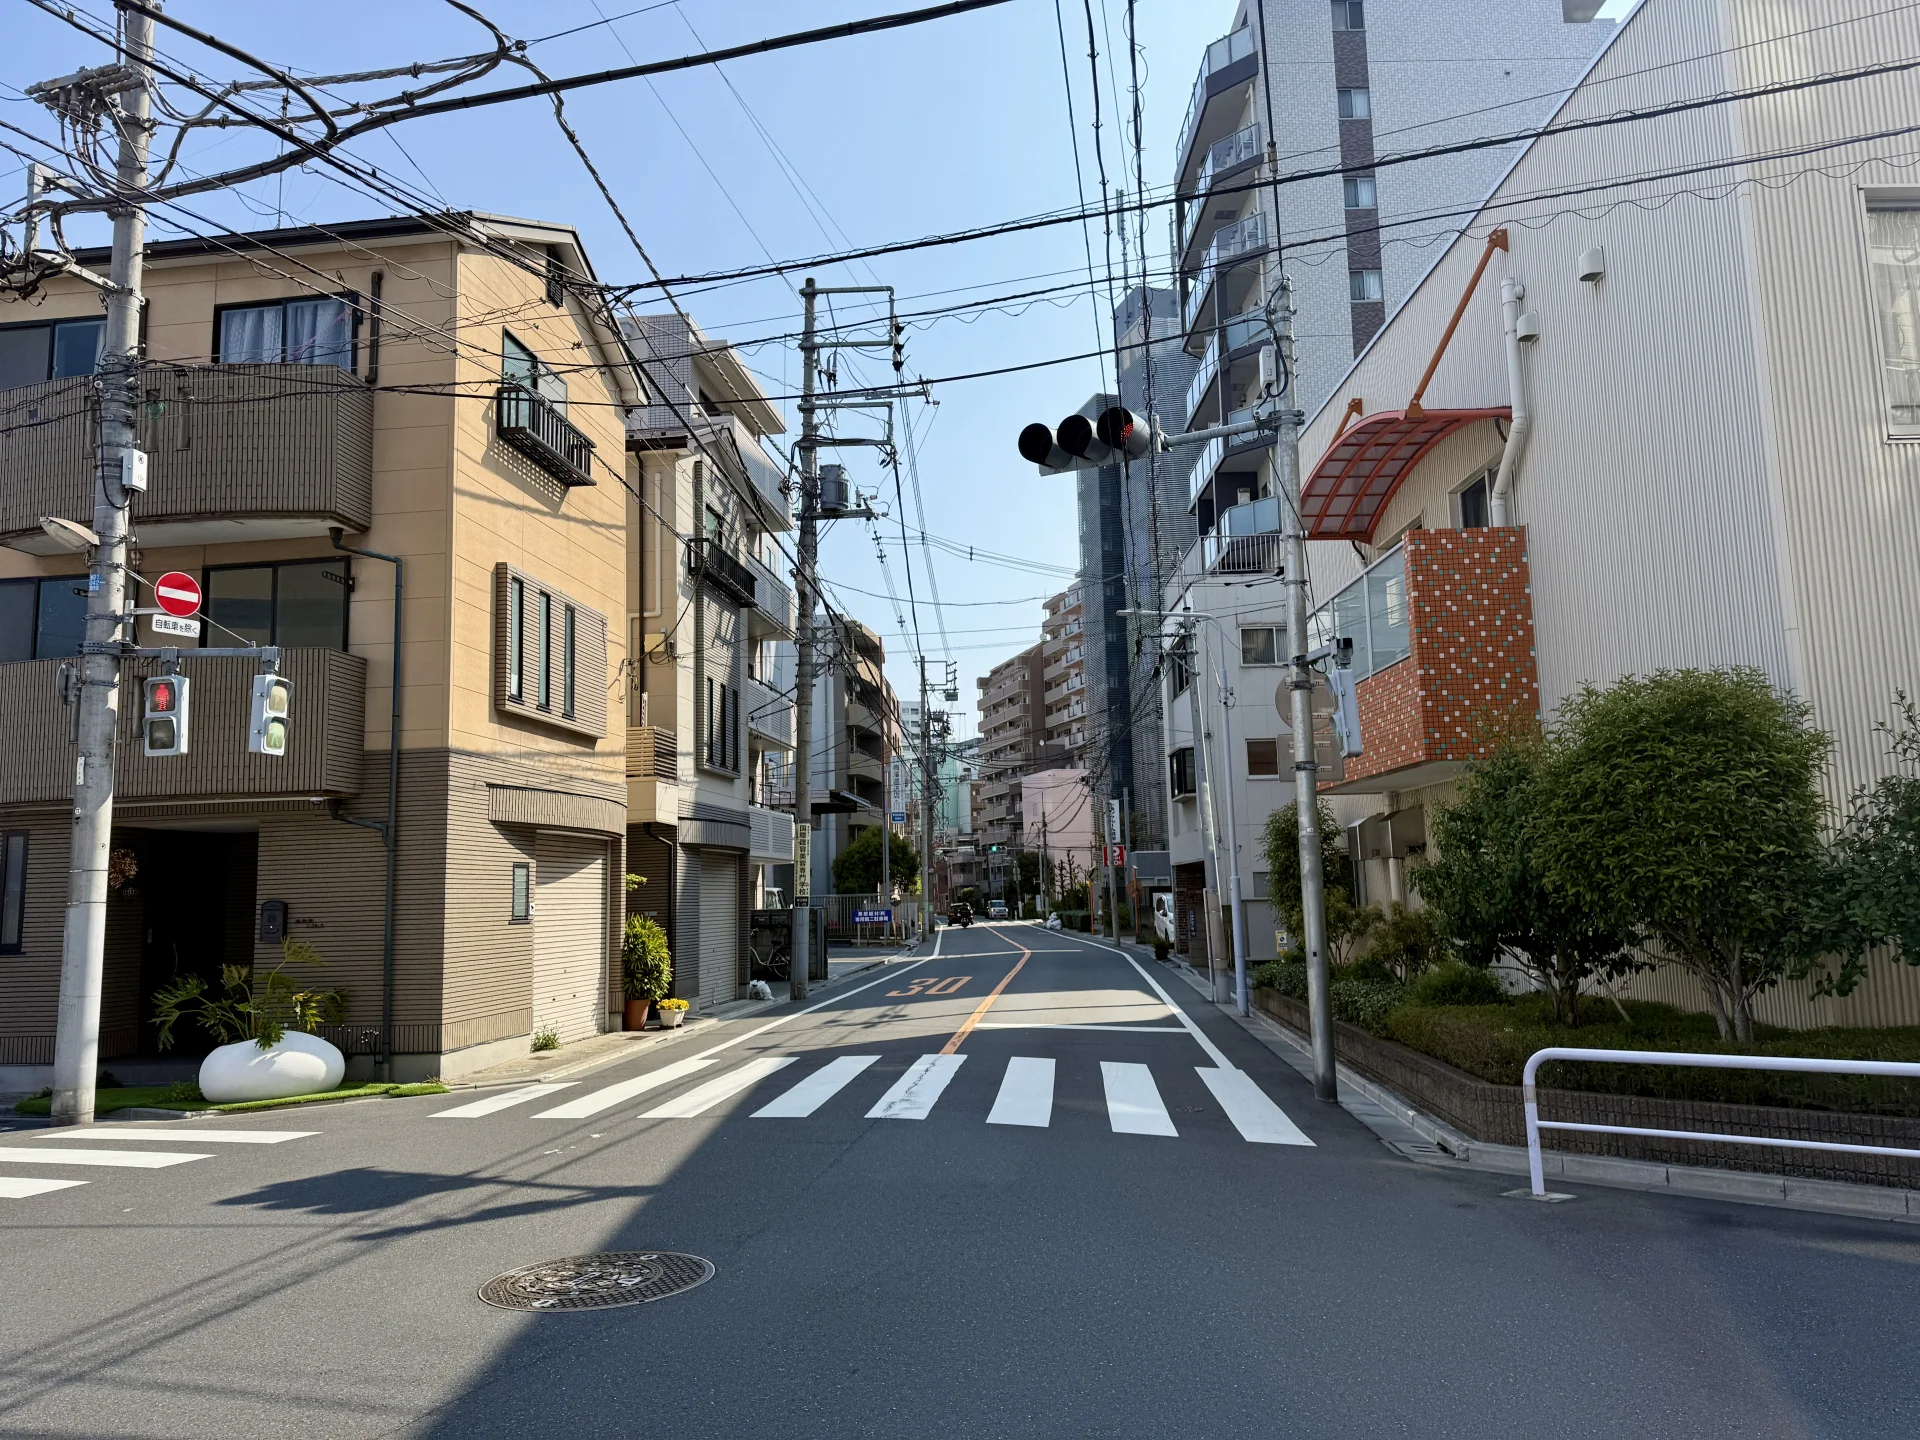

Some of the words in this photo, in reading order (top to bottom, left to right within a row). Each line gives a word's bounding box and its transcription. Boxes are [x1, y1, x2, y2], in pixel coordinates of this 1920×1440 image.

[155, 619, 198, 634] 自転車を除く
[885, 976, 973, 997] 30
